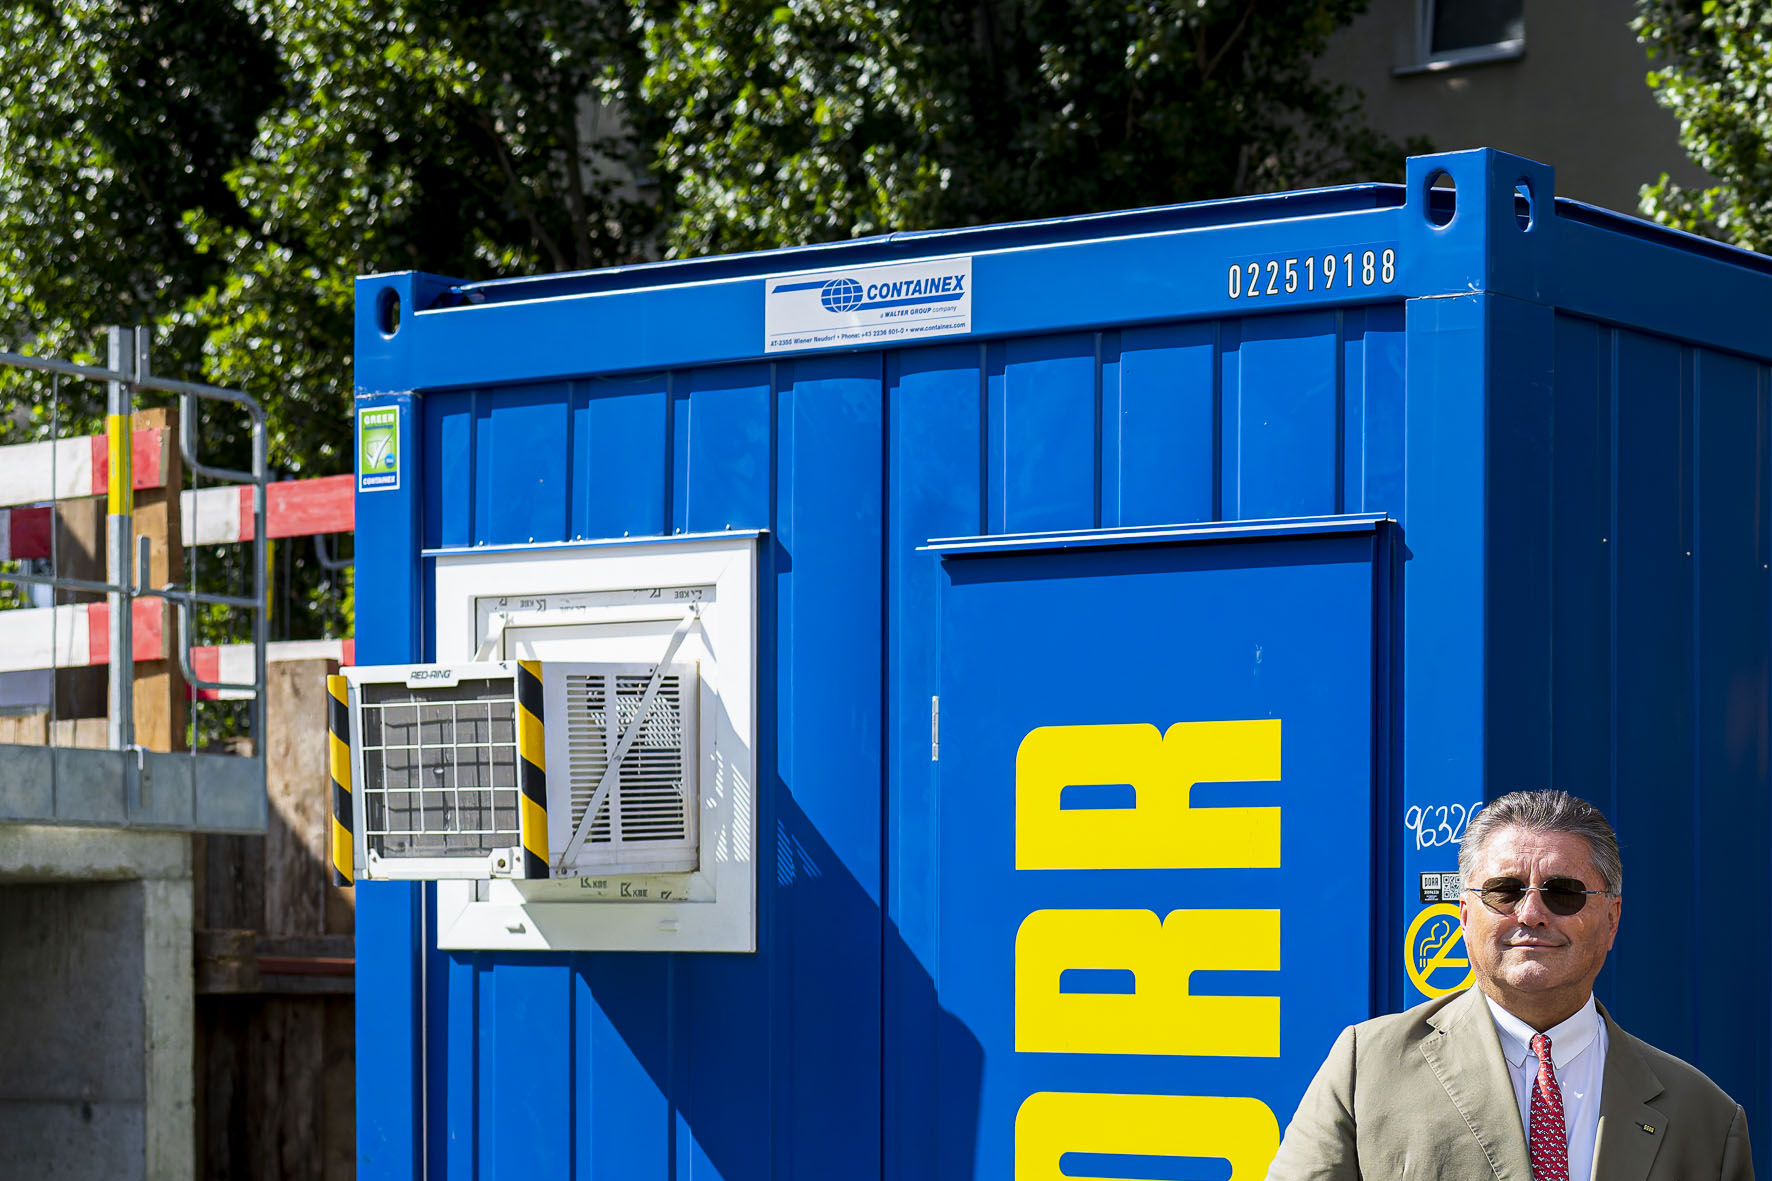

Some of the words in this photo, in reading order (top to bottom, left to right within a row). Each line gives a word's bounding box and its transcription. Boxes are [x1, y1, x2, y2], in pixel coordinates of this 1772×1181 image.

[1228, 248, 1396, 299] 022519188
[867, 274, 966, 301] CONTAINEX
[885, 309, 909, 318] WALTER
[910, 307, 932, 316] GROUP
[793, 336, 812, 345] Wiener
[813, 334, 836, 343] Neudorf
[841, 332, 860, 340] Phone:
[910, 321, 966, 333] www.containex.com
